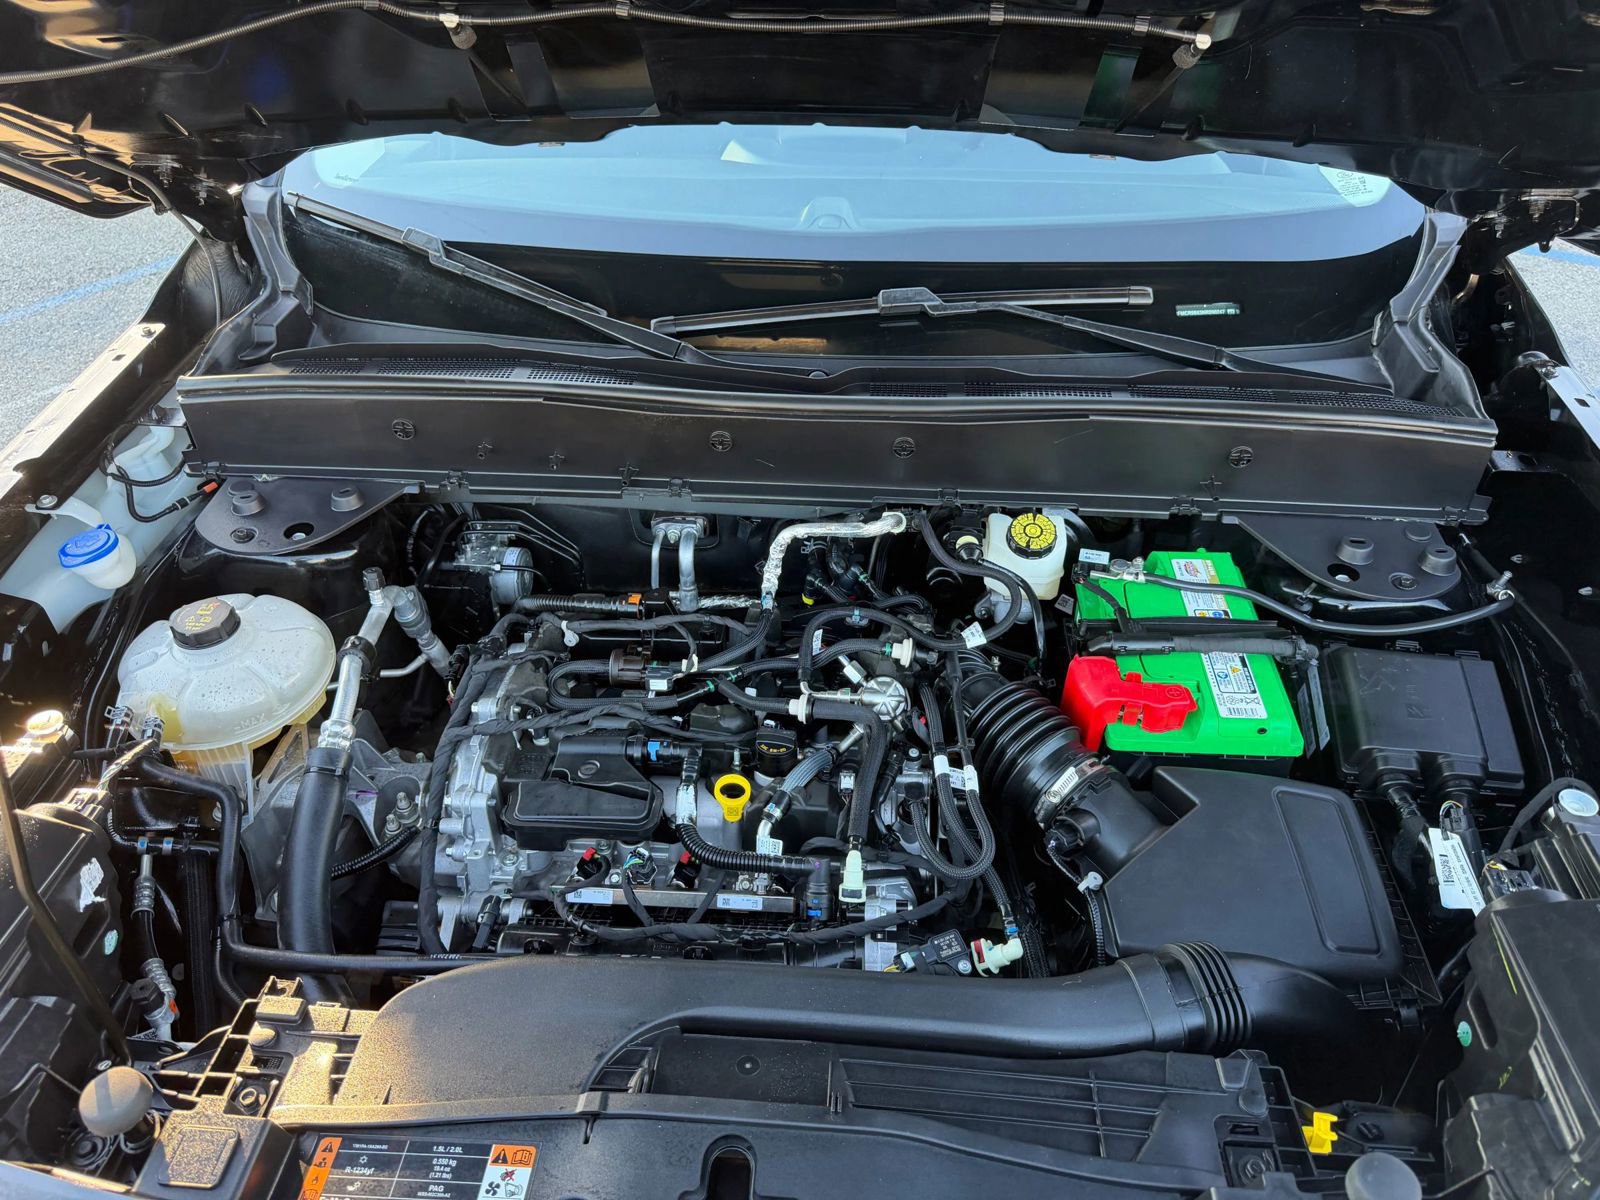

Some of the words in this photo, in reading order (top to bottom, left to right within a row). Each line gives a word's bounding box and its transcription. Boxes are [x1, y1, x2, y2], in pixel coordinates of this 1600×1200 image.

[432, 1145, 445, 1153] 1.5L
[450, 1146, 463, 1154] 2.0L
[428, 1184, 445, 1192] PAG
